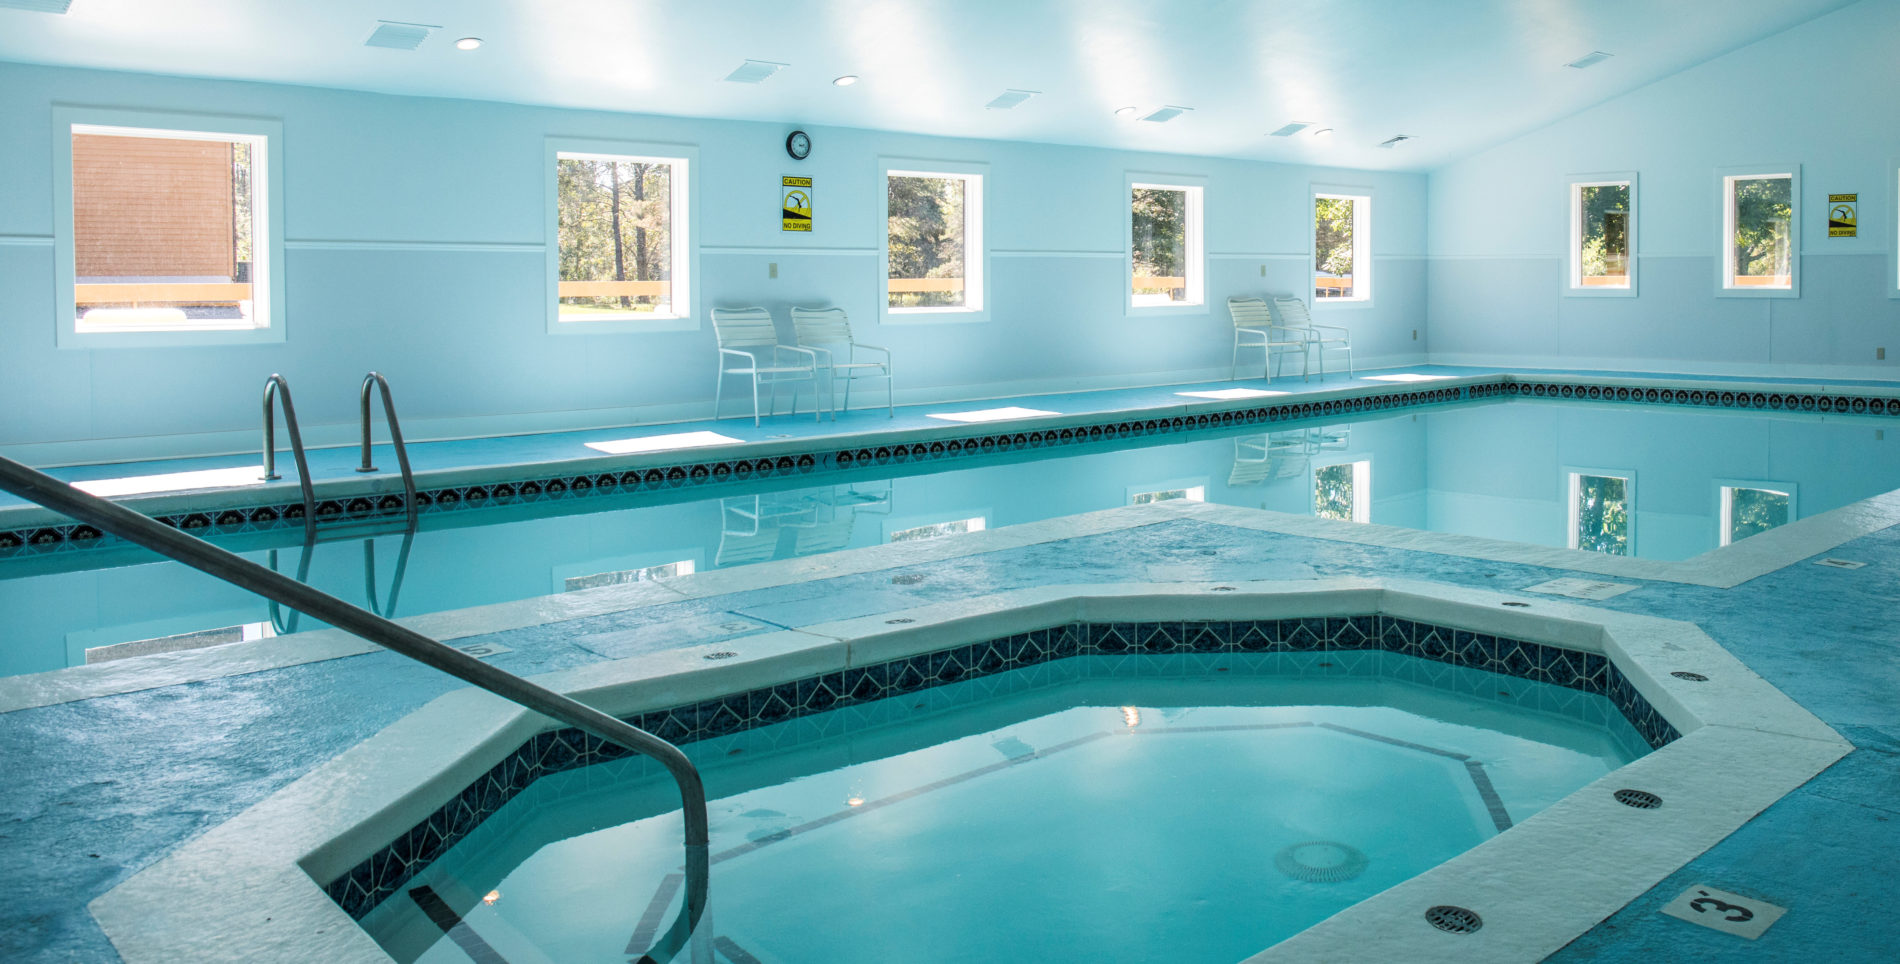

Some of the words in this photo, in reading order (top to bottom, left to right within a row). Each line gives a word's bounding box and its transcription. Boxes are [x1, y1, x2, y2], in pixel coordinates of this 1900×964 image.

[784, 178, 811, 186] CAUTION
[793, 222, 811, 230] DIVING
[1690, 890, 1753, 922] 3'
